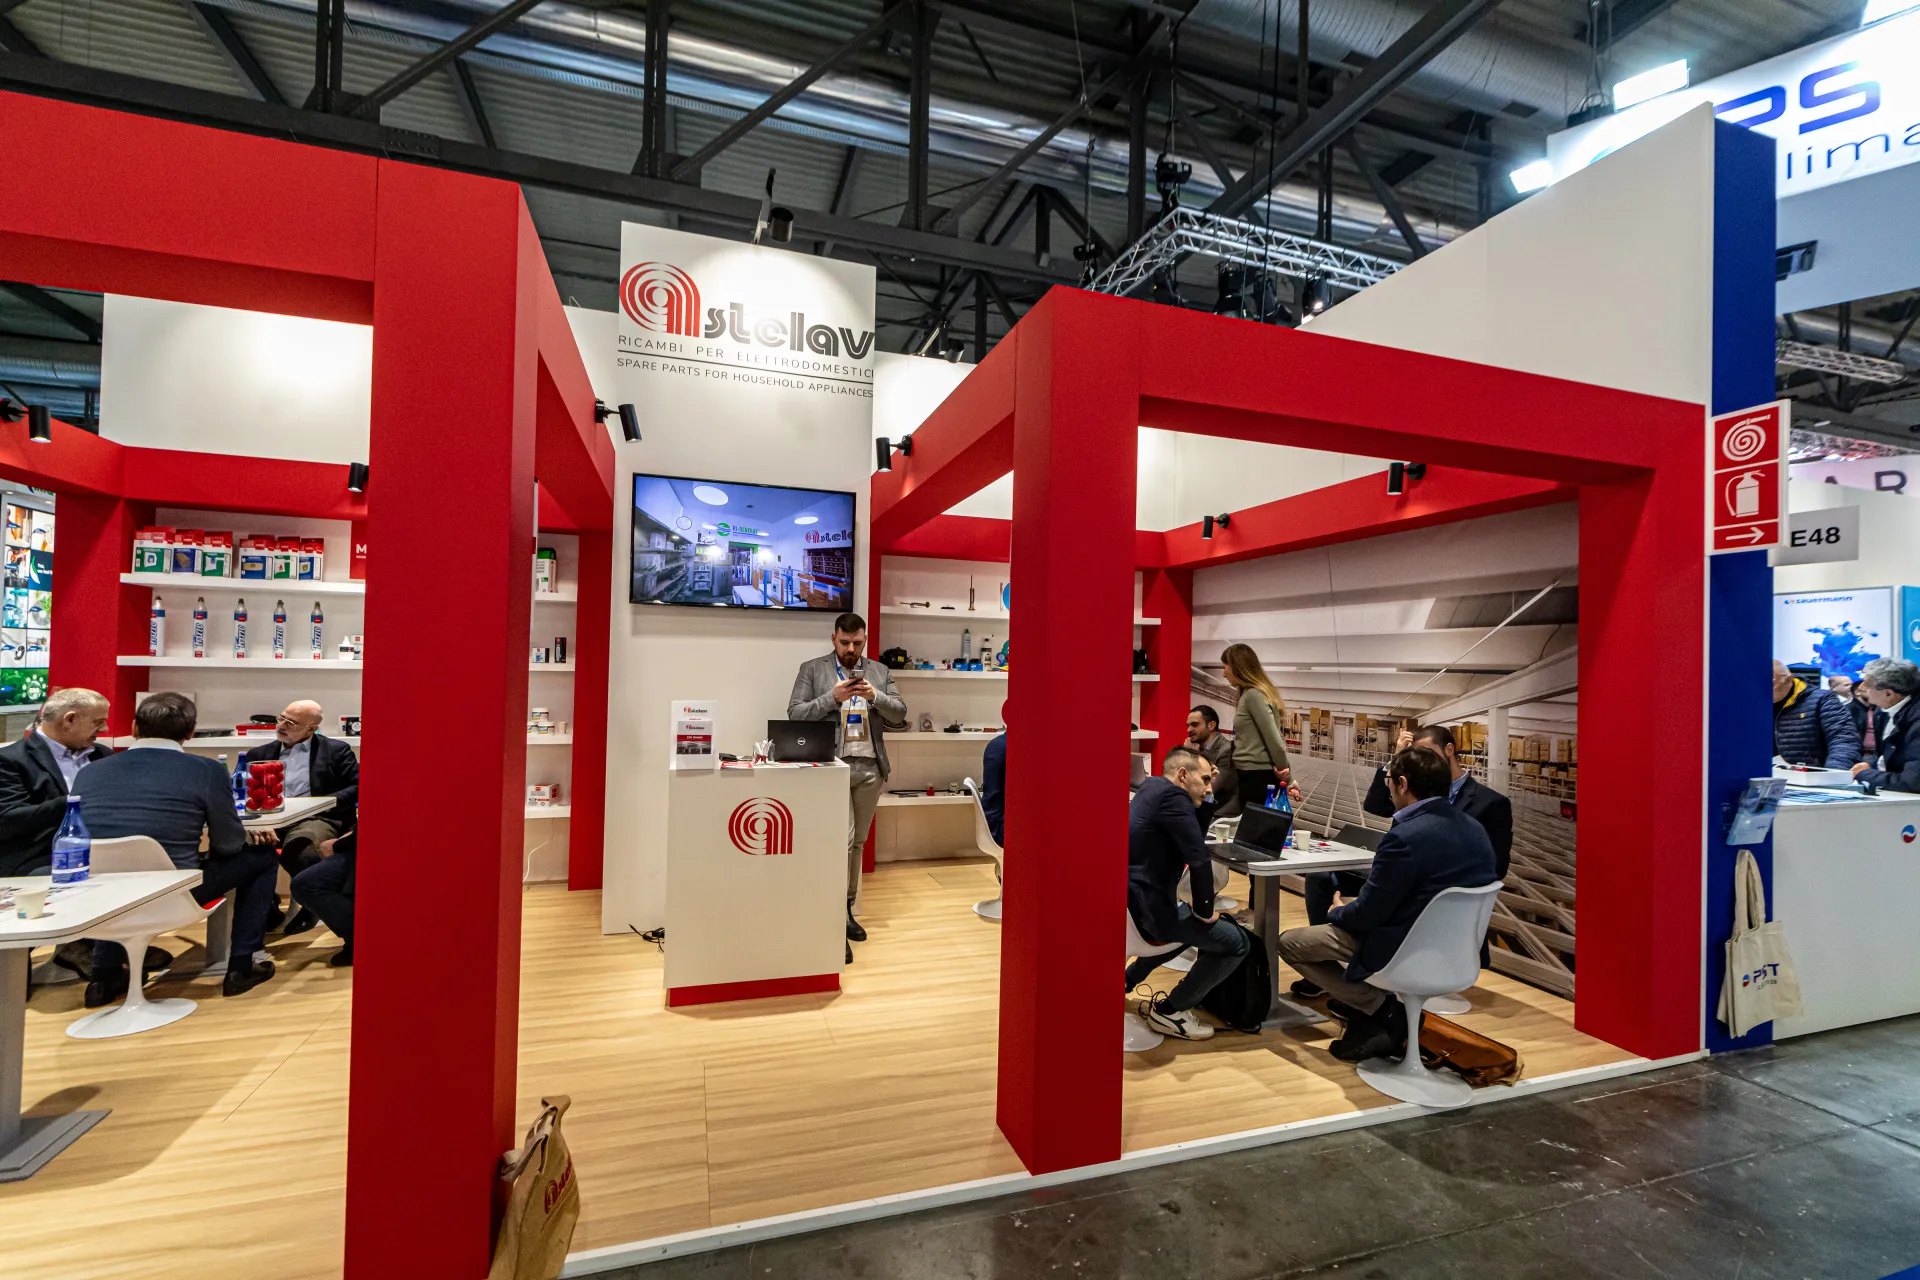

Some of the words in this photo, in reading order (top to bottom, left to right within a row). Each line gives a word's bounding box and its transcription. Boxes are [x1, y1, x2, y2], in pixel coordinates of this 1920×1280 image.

[1786, 123, 1920, 180] lima
[618, 334, 683, 353] RICAMBI
[696, 346, 724, 358] PER
[737, 351, 874, 378] ELETTRODOMESTICI
[617, 357, 657, 371] SPARE
[662, 363, 700, 376] PARTS
[705, 369, 728, 380] FOR
[733, 373, 804, 389] HOUSEHOLD
[808, 382, 874, 398] APPLIANCES
[1790, 526, 1841, 548] E48
